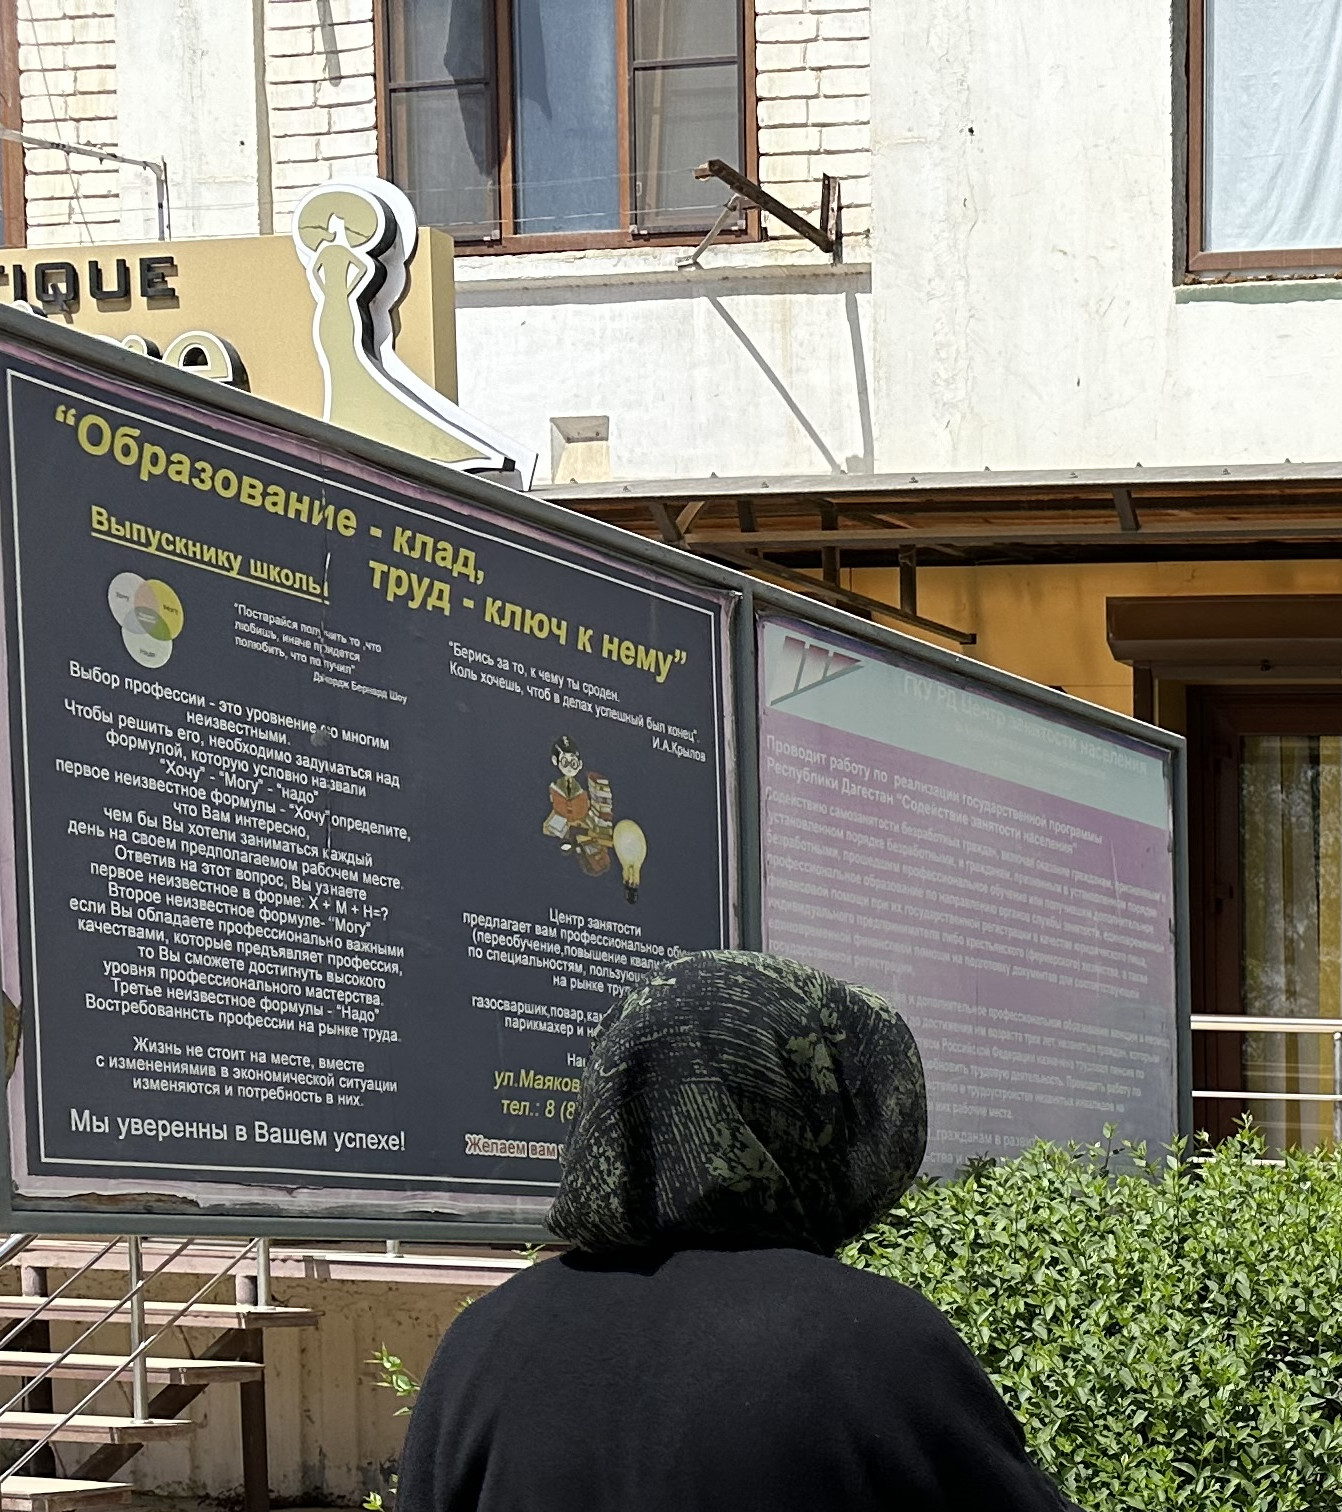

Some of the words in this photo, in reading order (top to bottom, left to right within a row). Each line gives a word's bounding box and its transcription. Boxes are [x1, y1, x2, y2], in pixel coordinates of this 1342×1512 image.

[90, 504, 243, 576] Выпускнику
[250, 558, 330, 598] школы
[393, 526, 485, 586] клад,
[369, 559, 451, 616] труд
[484, 596, 568, 646] ключ
[577, 625, 593, 654] к
[601, 633, 687, 683] нему”
[69, 660, 120, 689] Выбор
[124, 677, 205, 707] профессии
[218, 700, 242, 715] это
[245, 706, 317, 733] уровнение
[341, 729, 390, 750] многим
[186, 711, 291, 745] неизвестными.
[64, 698, 114, 724] Чтобы
[118, 714, 173, 737] решить
[177, 729, 205, 746] его,
[209, 734, 292, 764] необходимо
[295, 754, 372, 780] задуматься
[376, 771, 401, 789] над
[105, 728, 187, 761] формулой,
[191, 749, 249, 775] которую
[252, 764, 308, 785] условно
[311, 775, 367, 797] назвали
[766, 735, 827, 766] Проводит
[830, 755, 871, 780] работу
[873, 768, 888, 783] по
[894, 774, 959, 801] реализации
[962, 792, 1047, 829] государственной
[1049, 820, 1103, 845] программы
[766, 756, 839, 791] Республики
[841, 777, 894, 805] Дагестан
[971, 816, 1021, 839] занятости
[103, 807, 132, 823] чем
[137, 810, 158, 828] бы
[162, 814, 184, 833] Вы
[187, 822, 237, 842] хотели
[239, 832, 319, 858] заниматься
[322, 847, 373, 868] каждый
[69, 897, 106, 914] если
[110, 900, 133, 918] Вы
[137, 906, 215, 930] обладаете
[218, 920, 343, 949] профессионально
[346, 938, 404, 958] важными
[77, 918, 170, 945] качествами,
[173, 931, 233, 951] которые
[236, 939, 324, 963] предъявляет
[327, 952, 403, 977] профессия,
[462, 911, 533, 934] предлагает
[534, 925, 557, 939] вам
[560, 928, 665, 957] профессиональное
[549, 907, 585, 929] Центр
[587, 917, 642, 938] занятости
[102, 960, 156, 978] уровня
[160, 967, 302, 996] профессионального
[305, 985, 385, 1006] мастерства.
[137, 945, 155, 959] то
[159, 945, 180, 963] Вы
[184, 951, 245, 971] сможете
[248, 961, 323, 982] достигнуть
[326, 971, 386, 990] высокого
[85, 992, 214, 1022] Востребованнсть
[218, 1011, 295, 1032] профессии
[298, 1020, 315, 1033] на
[318, 1021, 359, 1038] рынке
[362, 1026, 402, 1044] труда.
[110, 977, 163, 998] Третье
[166, 987, 256, 1009] неизвестное
[259, 997, 324, 1016] формулы
[493, 1069, 581, 1093] ул.Маяков
[501, 1099, 540, 1117] тел.:
[545, 1100, 556, 1118] 8
[70, 1108, 109, 1133] Мы
[116, 1116, 228, 1141] уверенны
[235, 1124, 247, 1141] в
[254, 1120, 328, 1147] Вашем
[333, 1131, 406, 1152] успехе!
[465, 1134, 528, 1158] Желаем
[529, 1141, 558, 1160] вам
